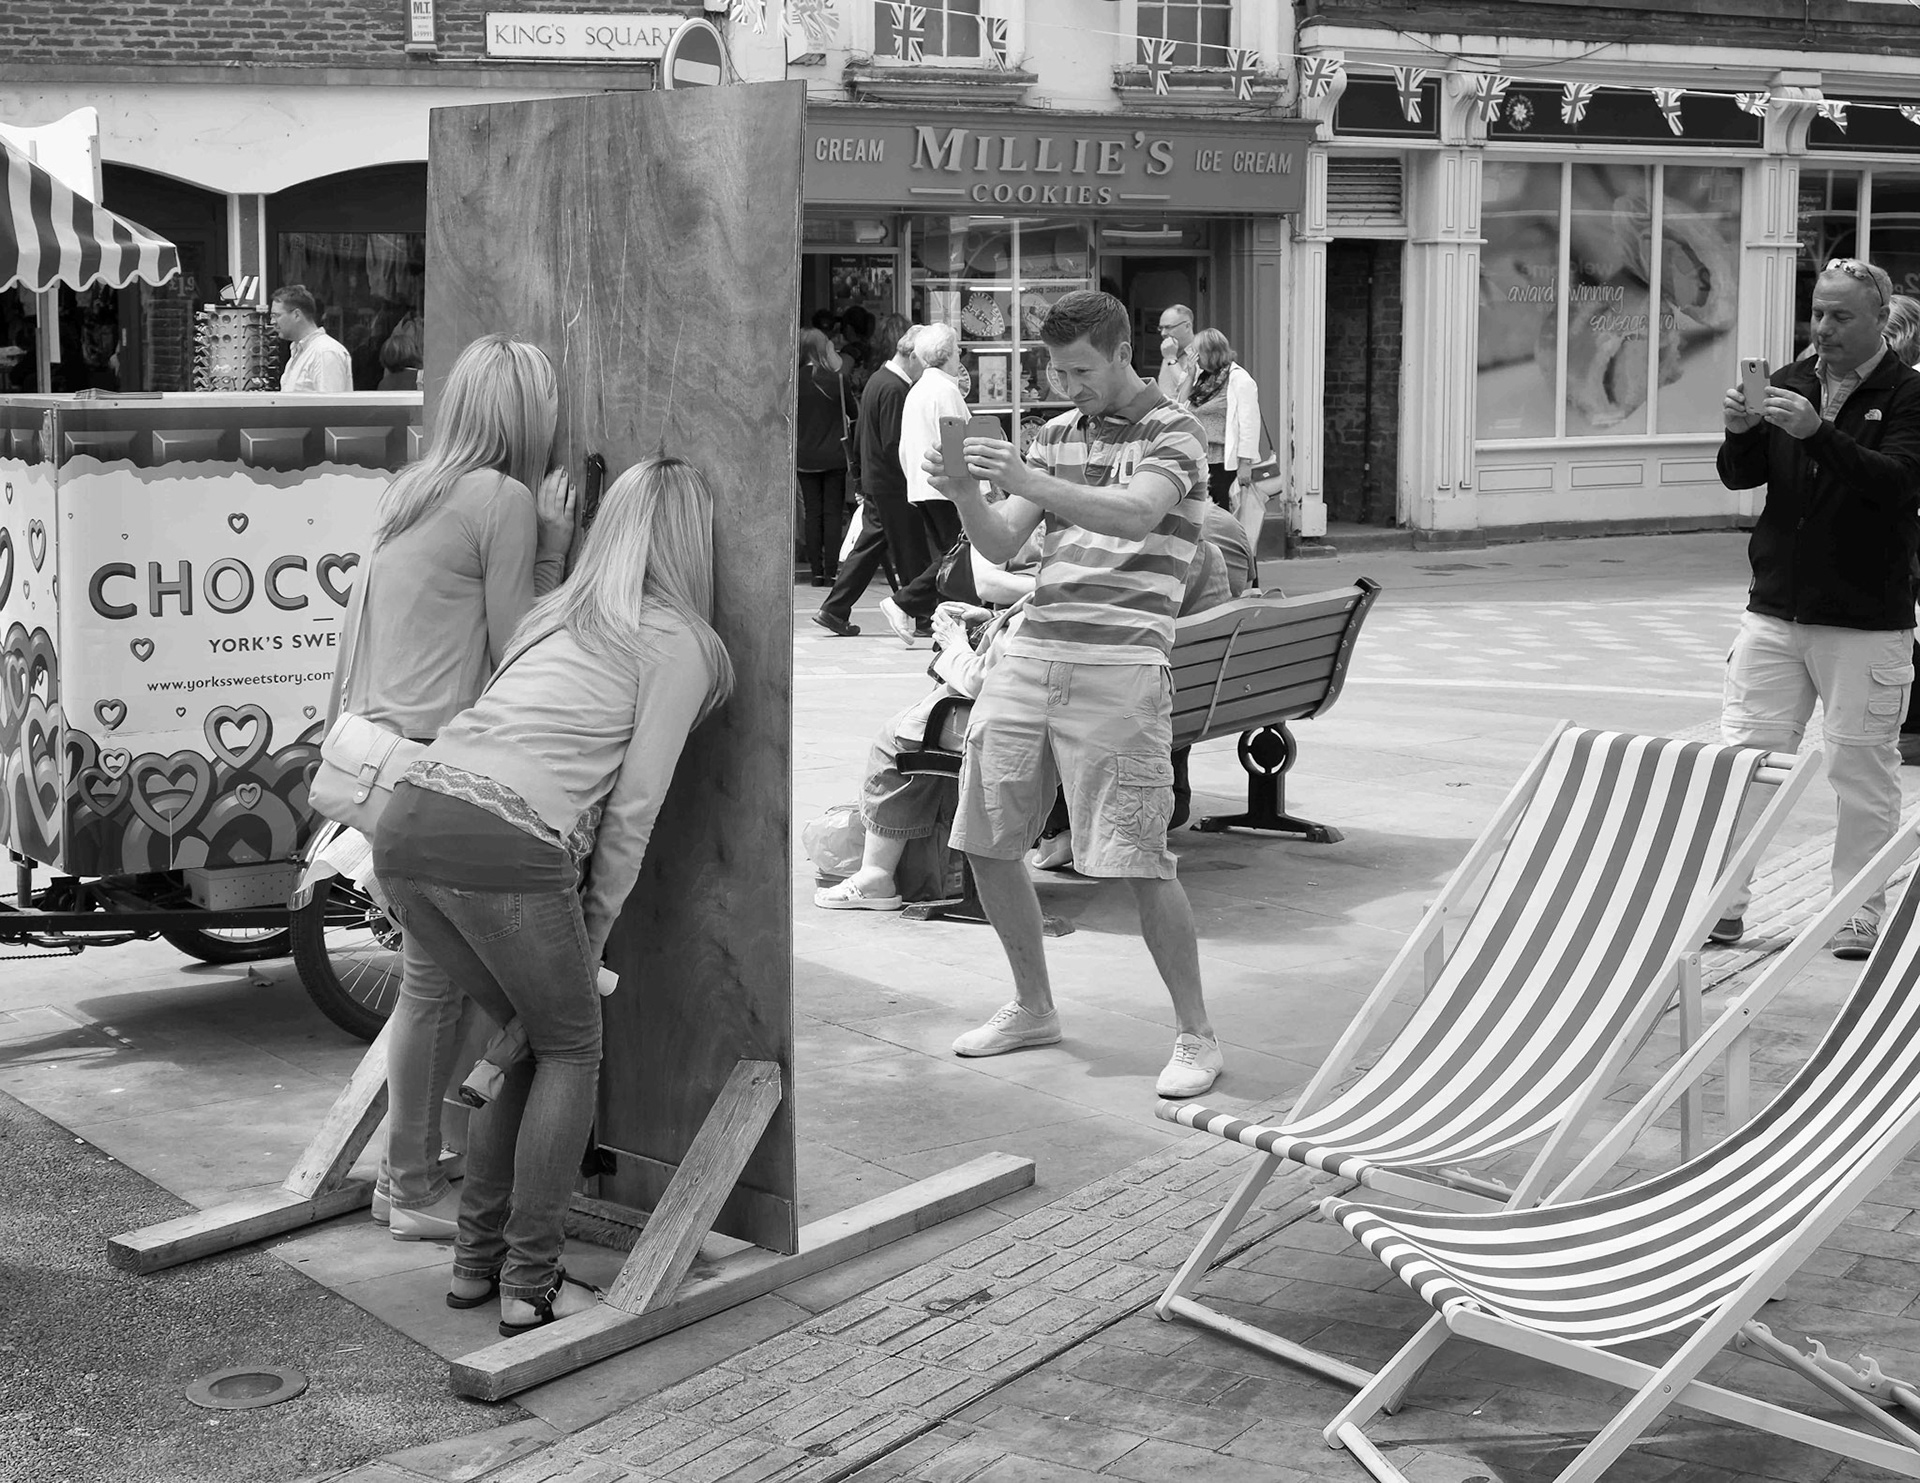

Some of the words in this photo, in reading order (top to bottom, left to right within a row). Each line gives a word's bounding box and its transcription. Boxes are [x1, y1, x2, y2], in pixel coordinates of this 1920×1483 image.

[495, 24, 566, 45] KING'S
[815, 136, 885, 163] CREAM
[911, 125, 1175, 176] MILLIE'S
[1195, 149, 1223, 172] ICE
[1233, 150, 1293, 174] CREAM
[972, 183, 1112, 205] COOKIES
[1508, 277, 1555, 303] award
[1568, 281, 1625, 314] winning
[1589, 314, 1647, 341] sausage
[209, 635, 283, 654] YORK'S
[292, 632, 342, 650] SWE
[147, 670, 334, 693] www.yorkssweetstory.com
